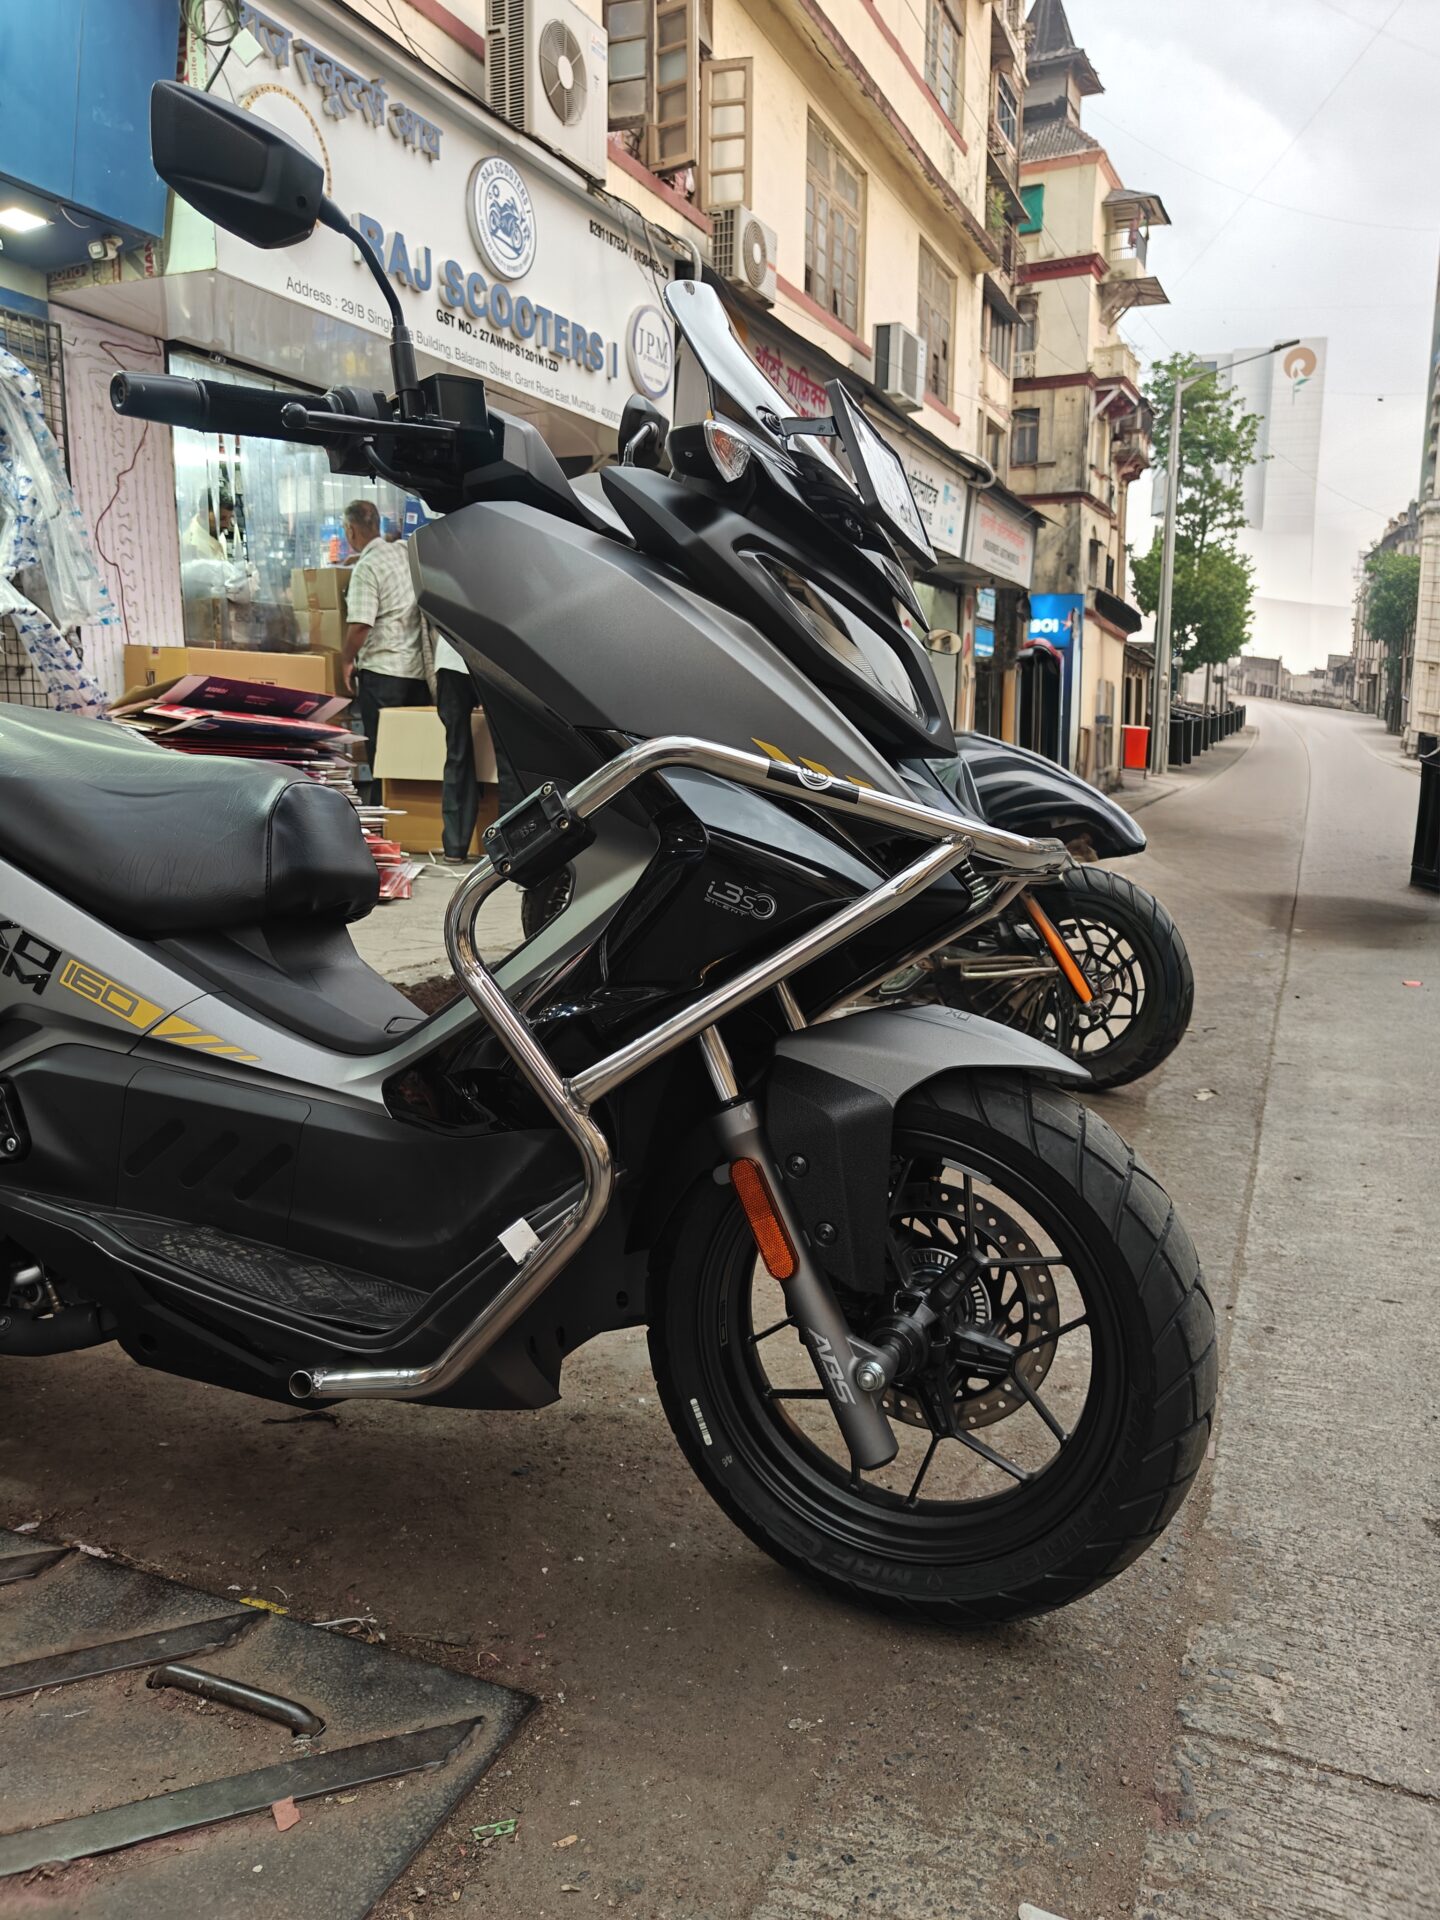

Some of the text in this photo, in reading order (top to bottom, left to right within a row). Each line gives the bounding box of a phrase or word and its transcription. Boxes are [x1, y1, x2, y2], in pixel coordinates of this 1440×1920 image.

[481, 163, 494, 184] RAJ
[495, 161, 529, 206] SCOOTERS
[286, 276, 332, 306] Address
[341, 298, 365, 319] 29/B
[352, 212, 431, 292] RAJ
[440, 260, 604, 373] SCOOTERS
[436, 309, 455, 328] GST
[638, 327, 668, 364] JPM
[63, 963, 139, 1018] 160
[808, 1328, 856, 1404] ABS
